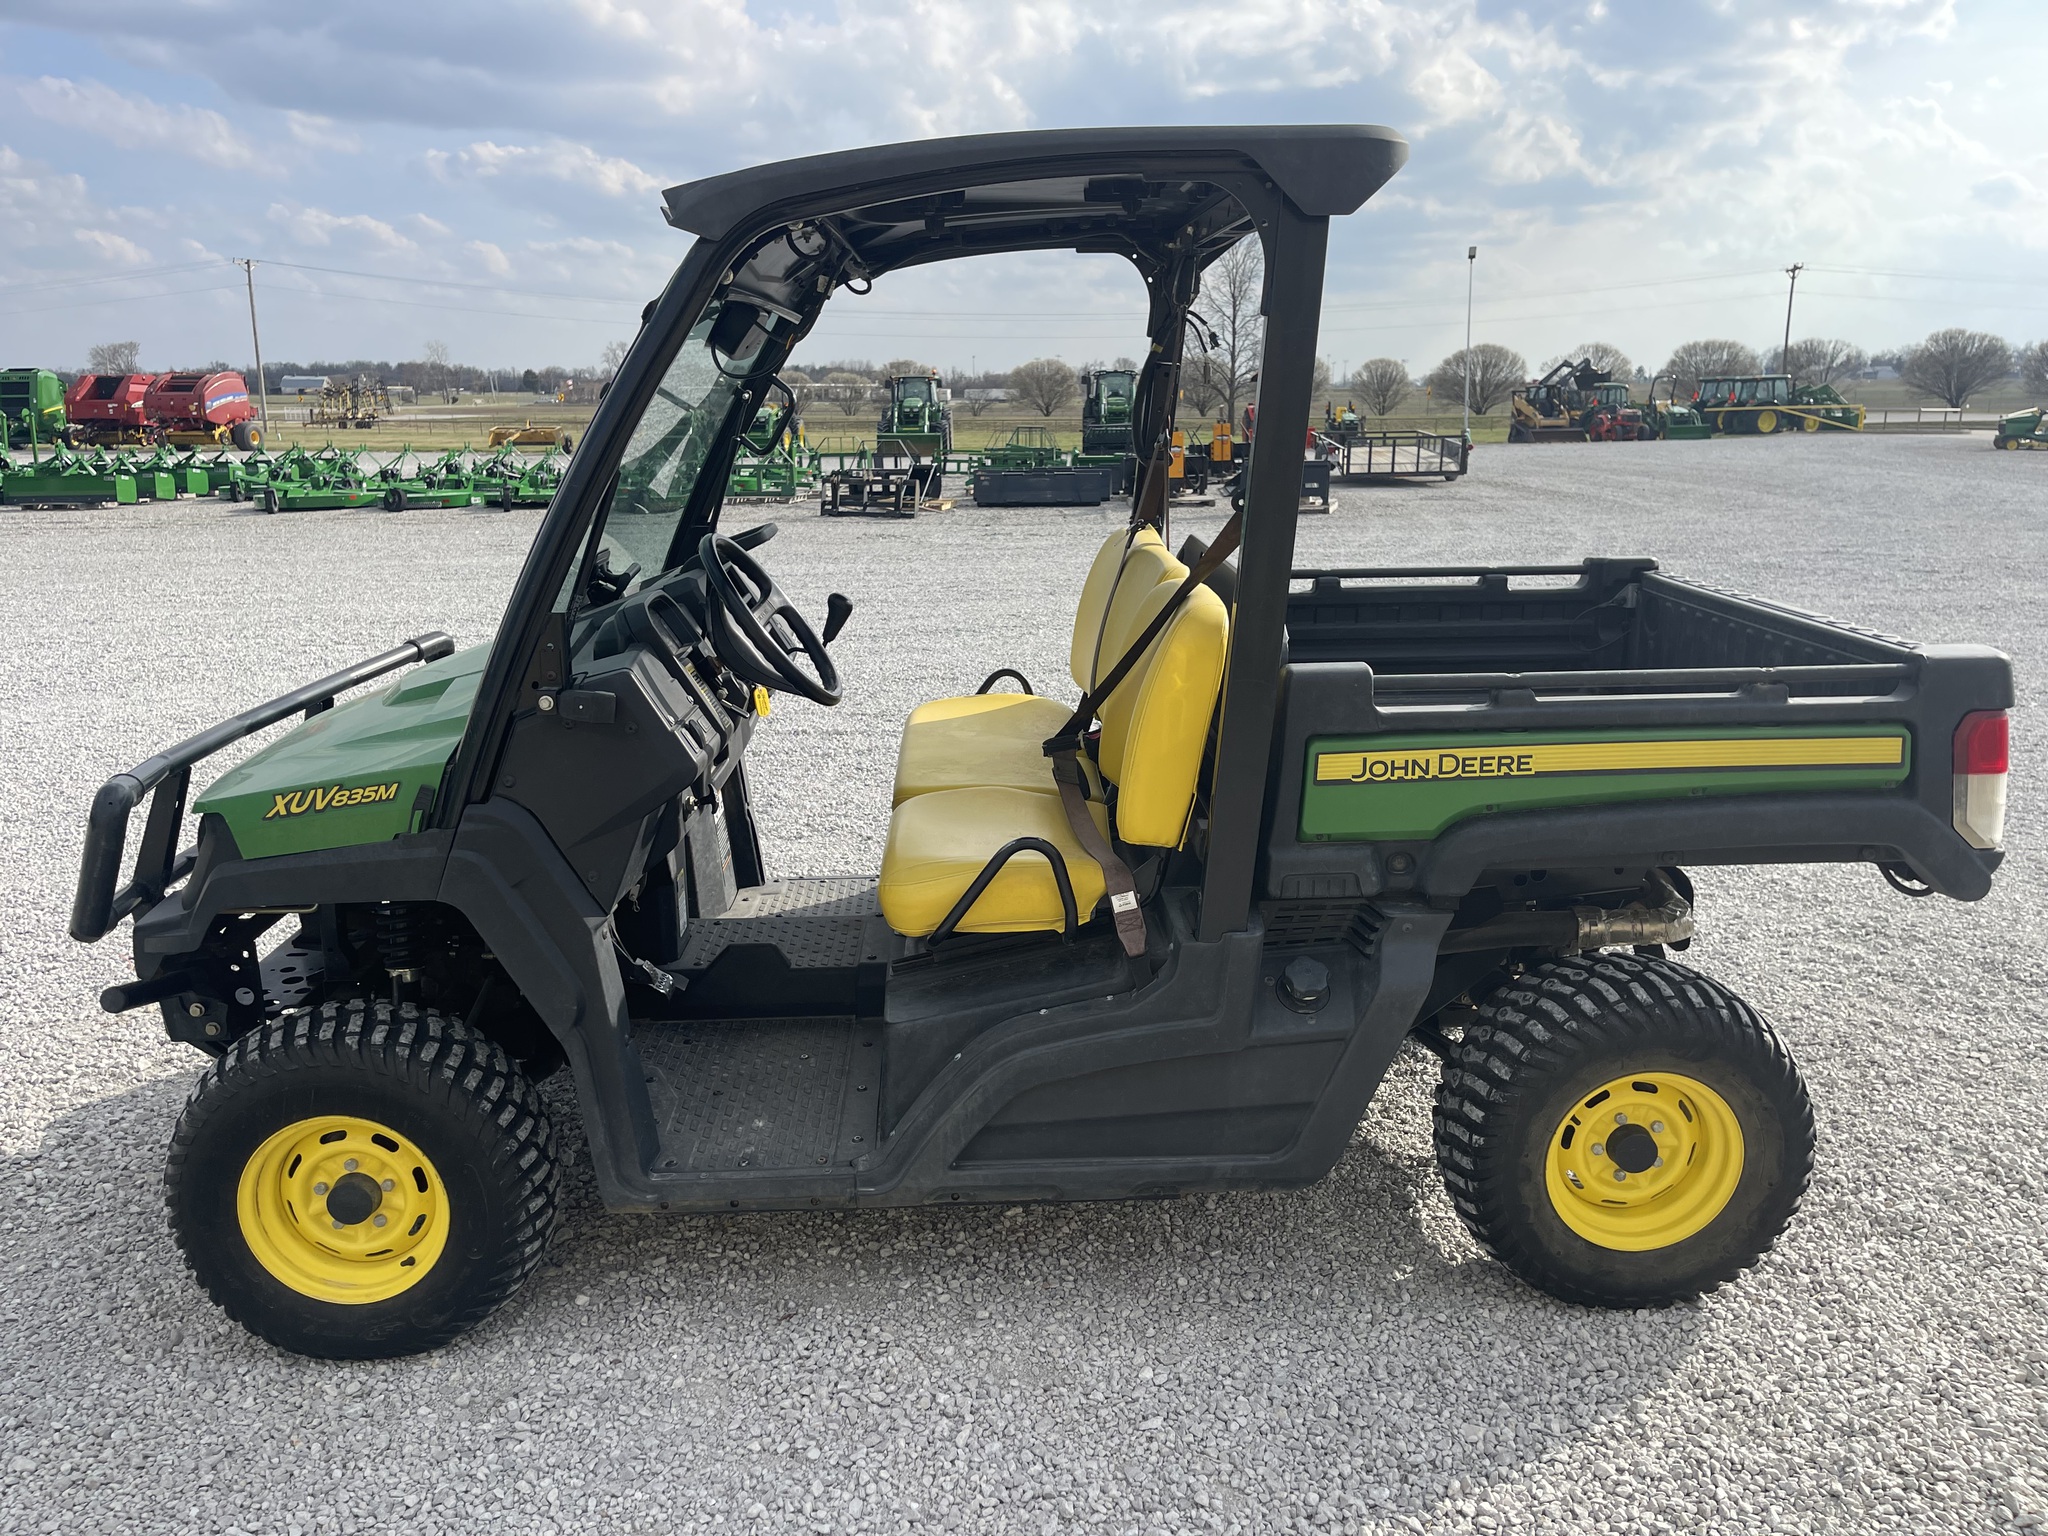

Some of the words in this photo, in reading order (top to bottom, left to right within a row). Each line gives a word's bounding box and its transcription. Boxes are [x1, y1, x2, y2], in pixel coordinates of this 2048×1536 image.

[1351, 756, 1430, 779] JOHN
[1438, 753, 1533, 775] DEERE
[264, 782, 399, 818] XUV835M
